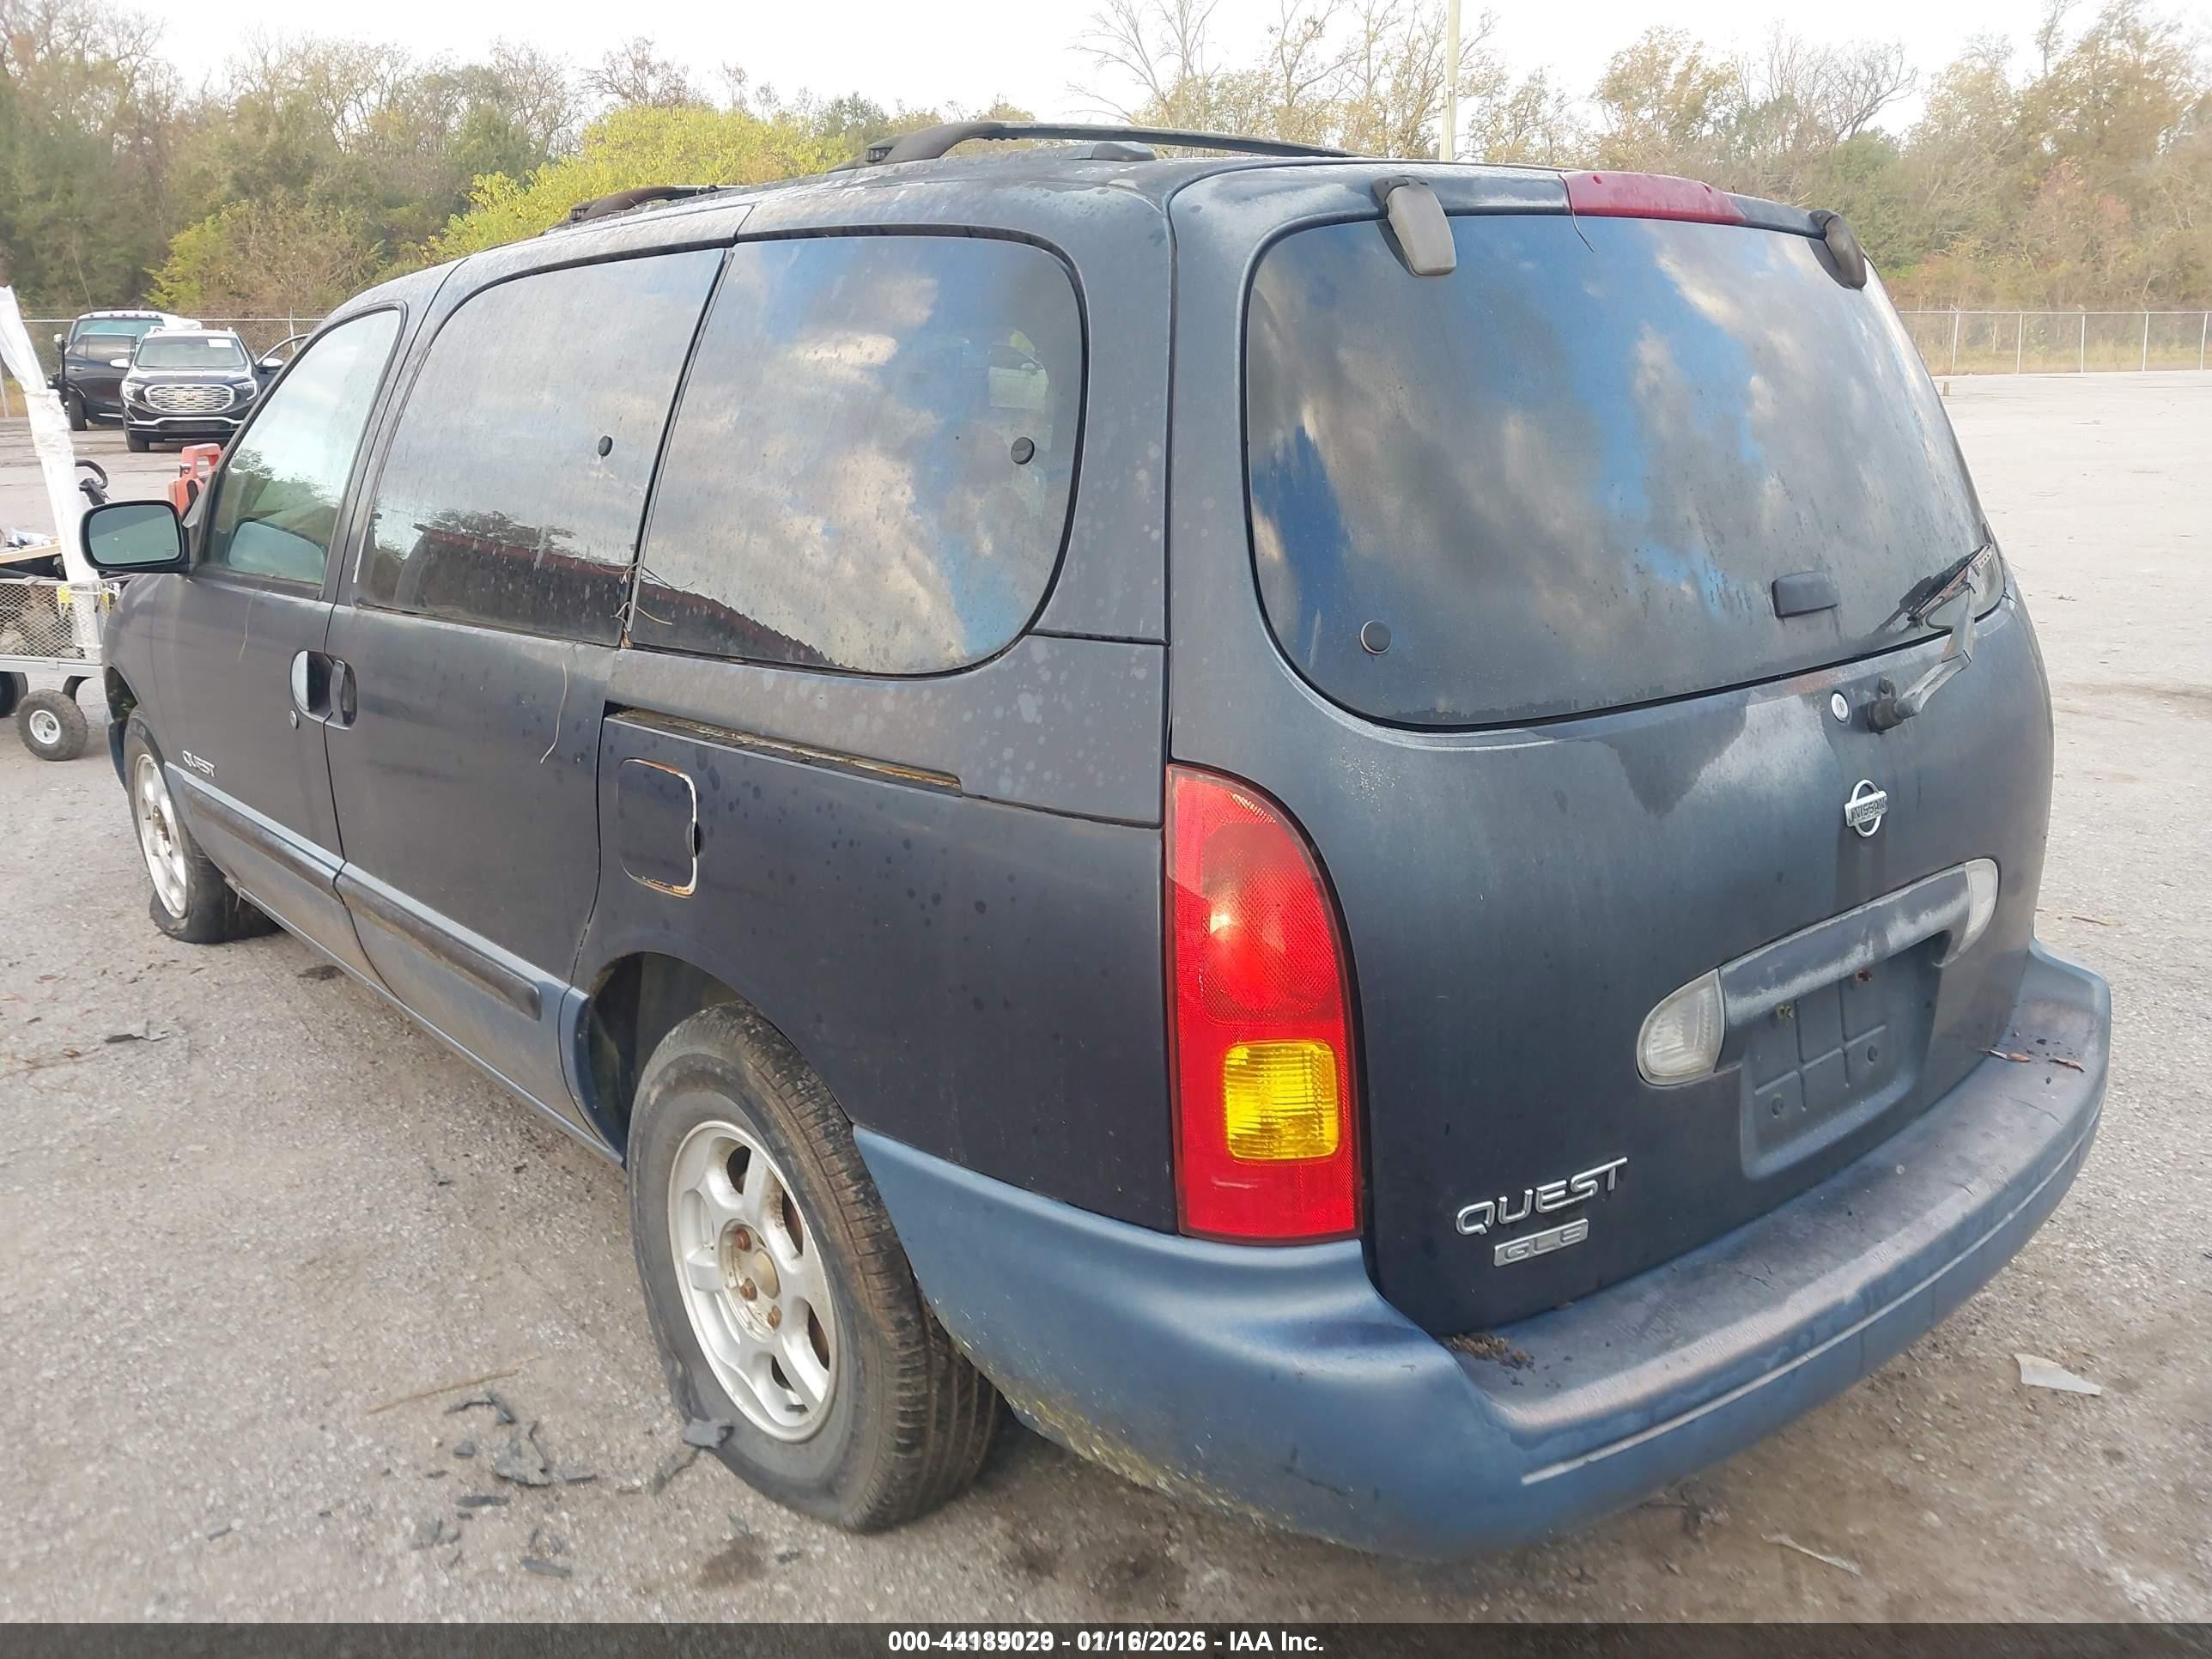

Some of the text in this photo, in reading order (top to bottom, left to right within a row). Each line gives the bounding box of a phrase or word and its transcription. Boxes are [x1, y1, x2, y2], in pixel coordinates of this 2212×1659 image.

[183, 750, 215, 777] QUEST
[1849, 796, 1887, 825] NISSAN
[1455, 1157, 1628, 1236] QUEST
[1504, 1226, 1583, 1262] GLE
